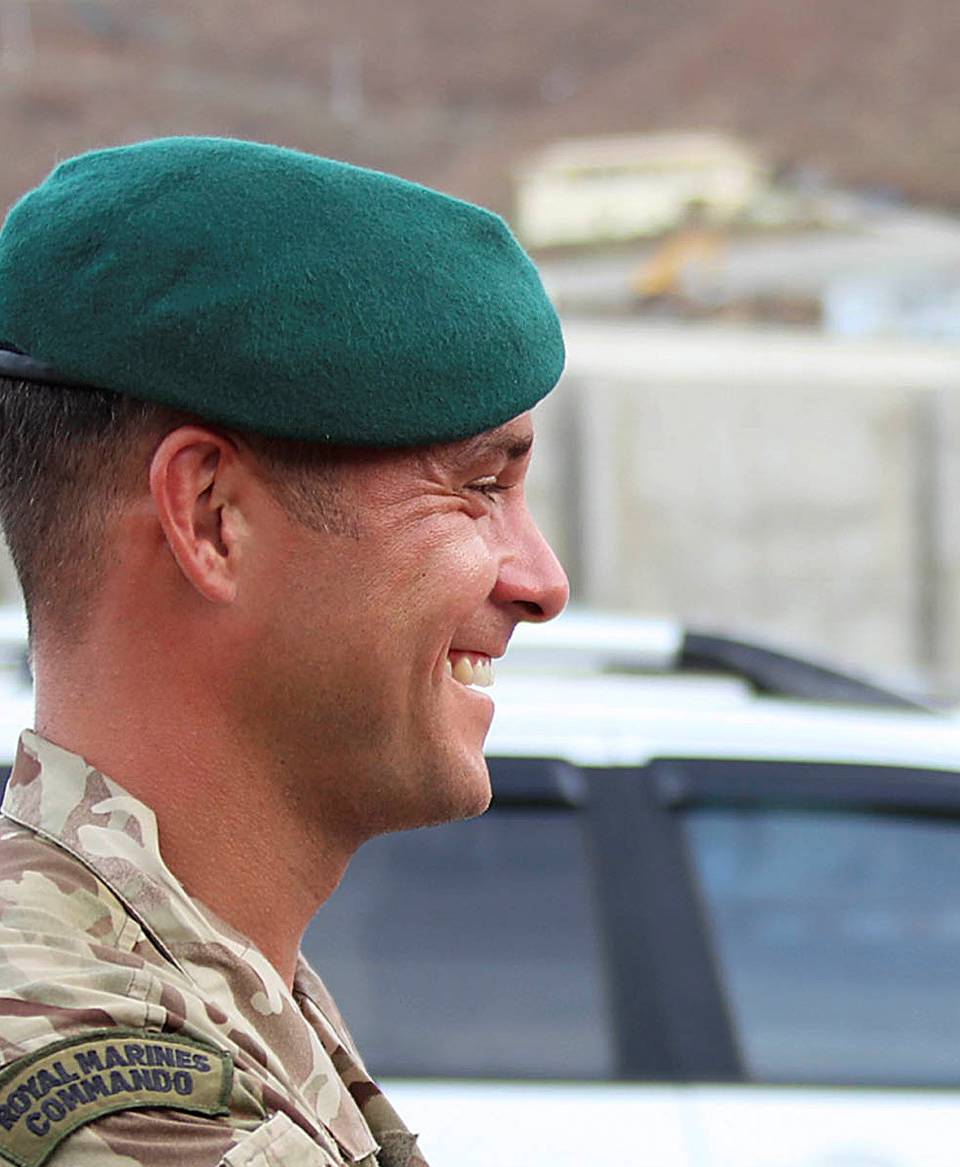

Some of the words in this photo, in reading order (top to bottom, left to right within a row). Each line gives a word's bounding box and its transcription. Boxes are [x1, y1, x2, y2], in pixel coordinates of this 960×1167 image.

[0, 1061, 80, 1131] ROYAL
[74, 1043, 212, 1076] MARINES
[26, 1069, 194, 1137] COMMANDO
